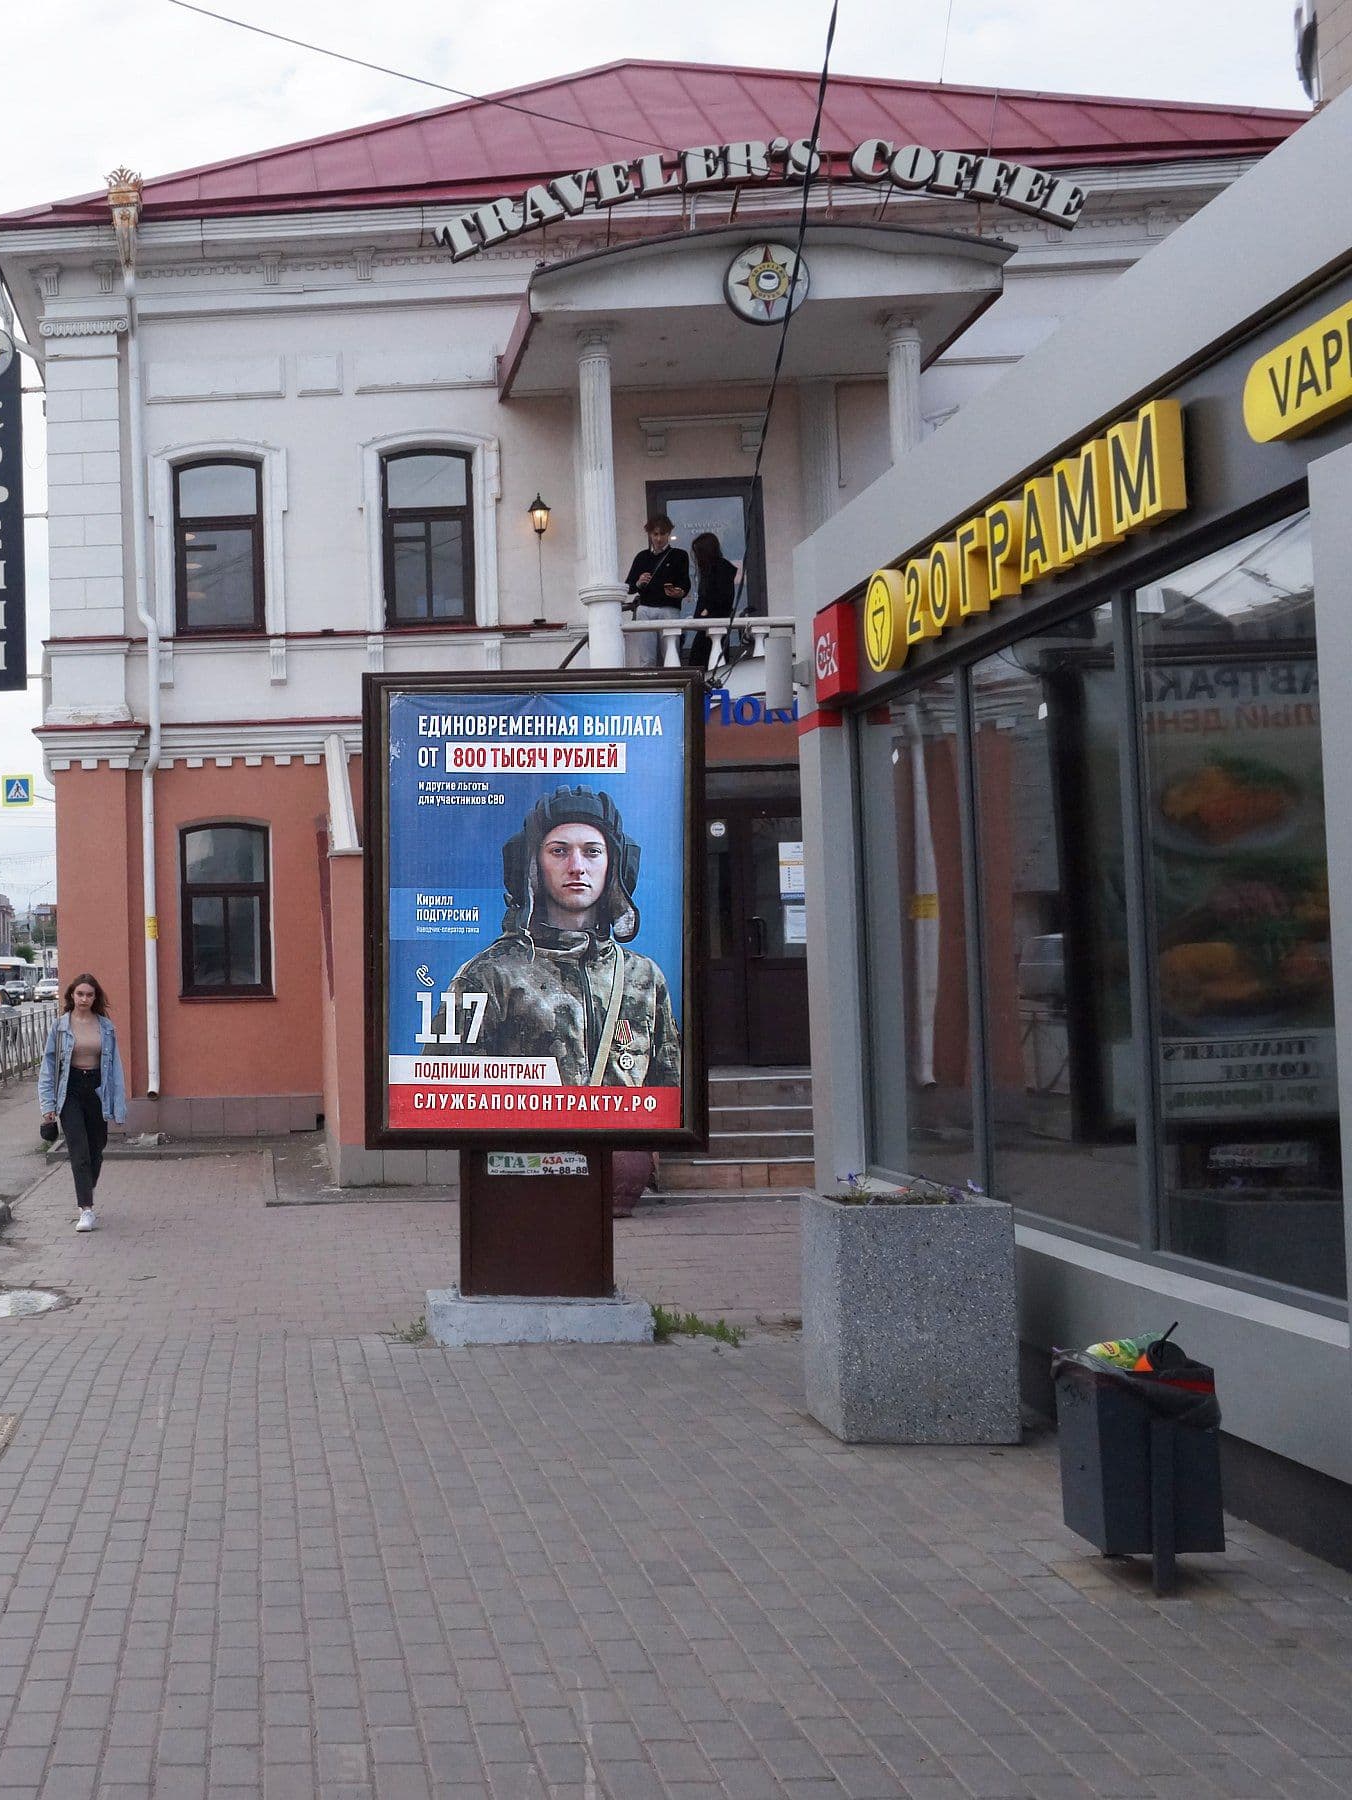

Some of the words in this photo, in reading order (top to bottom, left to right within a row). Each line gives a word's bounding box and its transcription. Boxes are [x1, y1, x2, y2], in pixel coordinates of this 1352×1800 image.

[433, 137, 822, 264] TRAVELER'S
[851, 138, 1089, 231] COFFEE
[1268, 317, 1352, 417] VAP
[417, 715, 579, 738] ЕДИНОВРЕМЕННАЯ
[583, 715, 663, 737] ВЫПЛАТА
[417, 746, 439, 768] ОТ
[453, 747, 487, 768] 800
[491, 747, 548, 768] ТЫСЯЧ
[553, 743, 618, 768] РУБЛЕЙ
[418, 781, 424, 791] и
[425, 782, 456, 794] другие
[457, 781, 489, 791] льготы
[418, 795, 435, 806] для
[435, 795, 486, 807] участников
[487, 795, 505, 806] СВО
[416, 893, 453, 908] Кирилл
[416, 907, 479, 922] ПОДГУРСКИЙ
[415, 991, 489, 1044] 117
[414, 1062, 480, 1080] ПОДПИШИ
[483, 1063, 547, 1080] КОНТРАКТ
[413, 1092, 658, 1112] СЛУЖБАПОКОНТРАКТУ.РФ
[542, 1166, 588, 1175] 94-88-88
